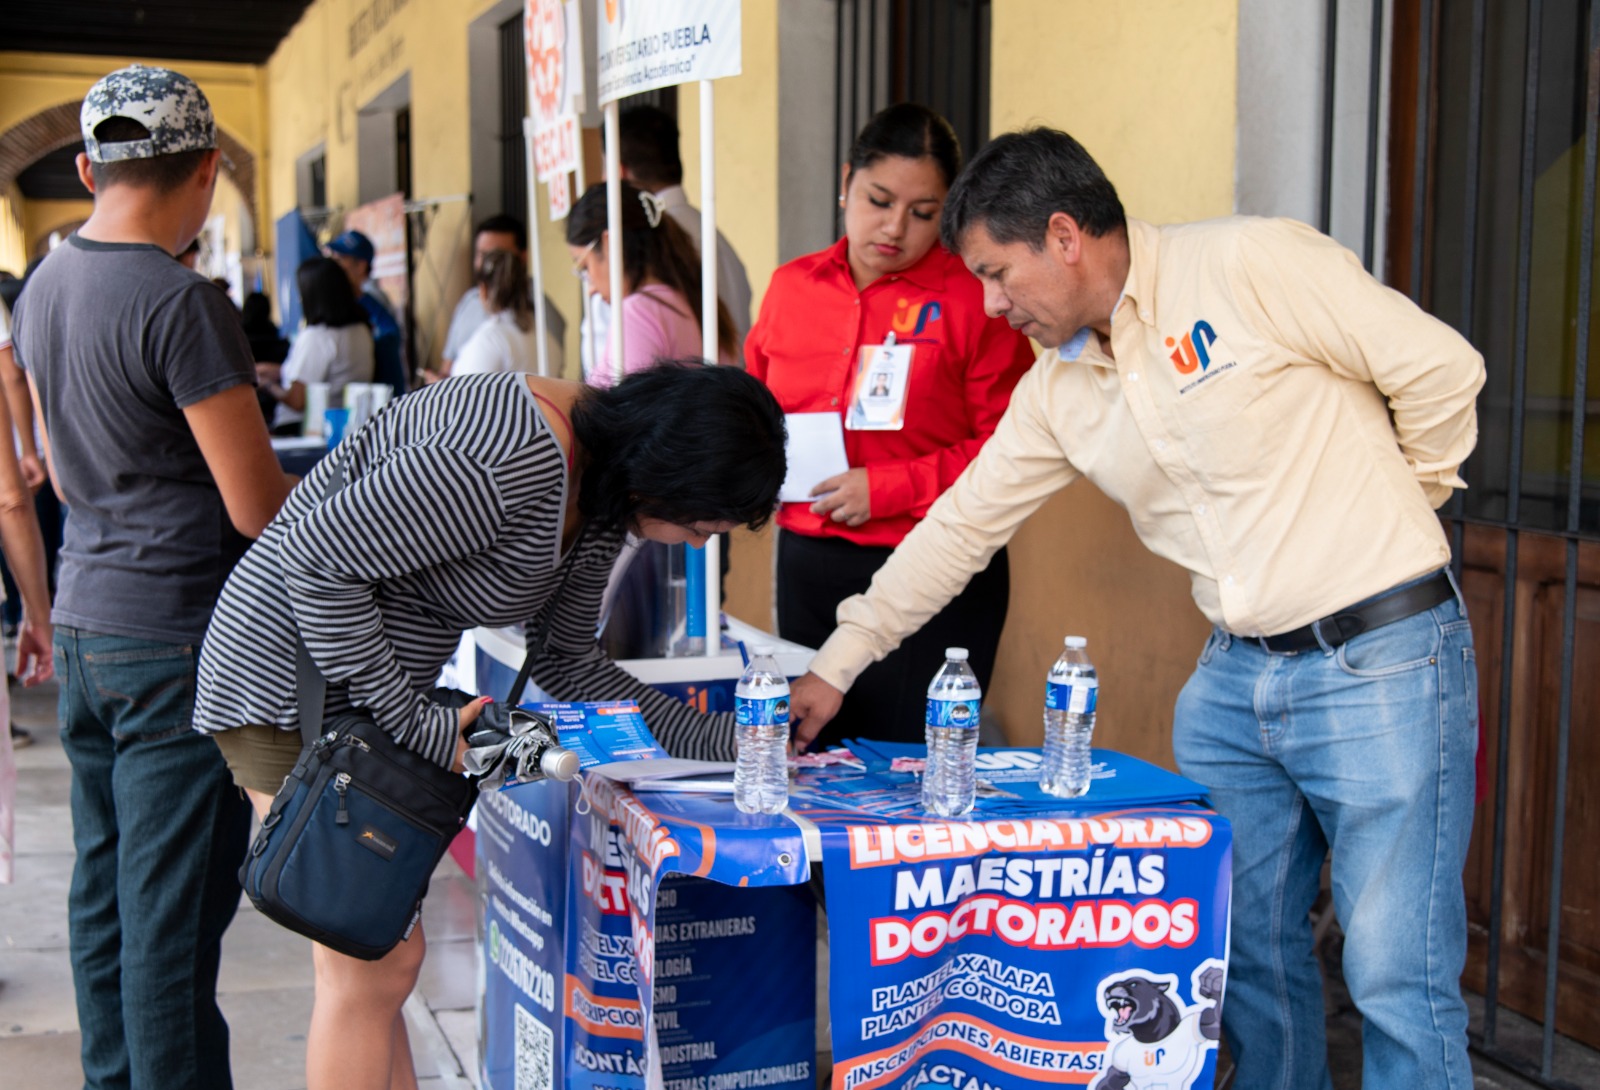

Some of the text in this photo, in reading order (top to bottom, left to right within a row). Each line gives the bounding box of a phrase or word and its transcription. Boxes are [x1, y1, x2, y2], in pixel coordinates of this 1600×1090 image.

[662, 23, 712, 51] PUEBLA
[852, 816, 1210, 866] LICENCIATURAS
[894, 847, 1166, 911] MAESTRÍAS
[680, 916, 756, 941] EXTRANJERAS
[873, 897, 1197, 962] DOCTORADOS
[863, 973, 1060, 1039] PLANTEL CÓRDOBA
[874, 953, 1054, 1009] PLANTEL XALAPA
[708, 1061, 810, 1090] COMPUTACIONALES
[845, 1023, 1105, 1090] ¡INSCRIPCIONES ABIERTAS!
